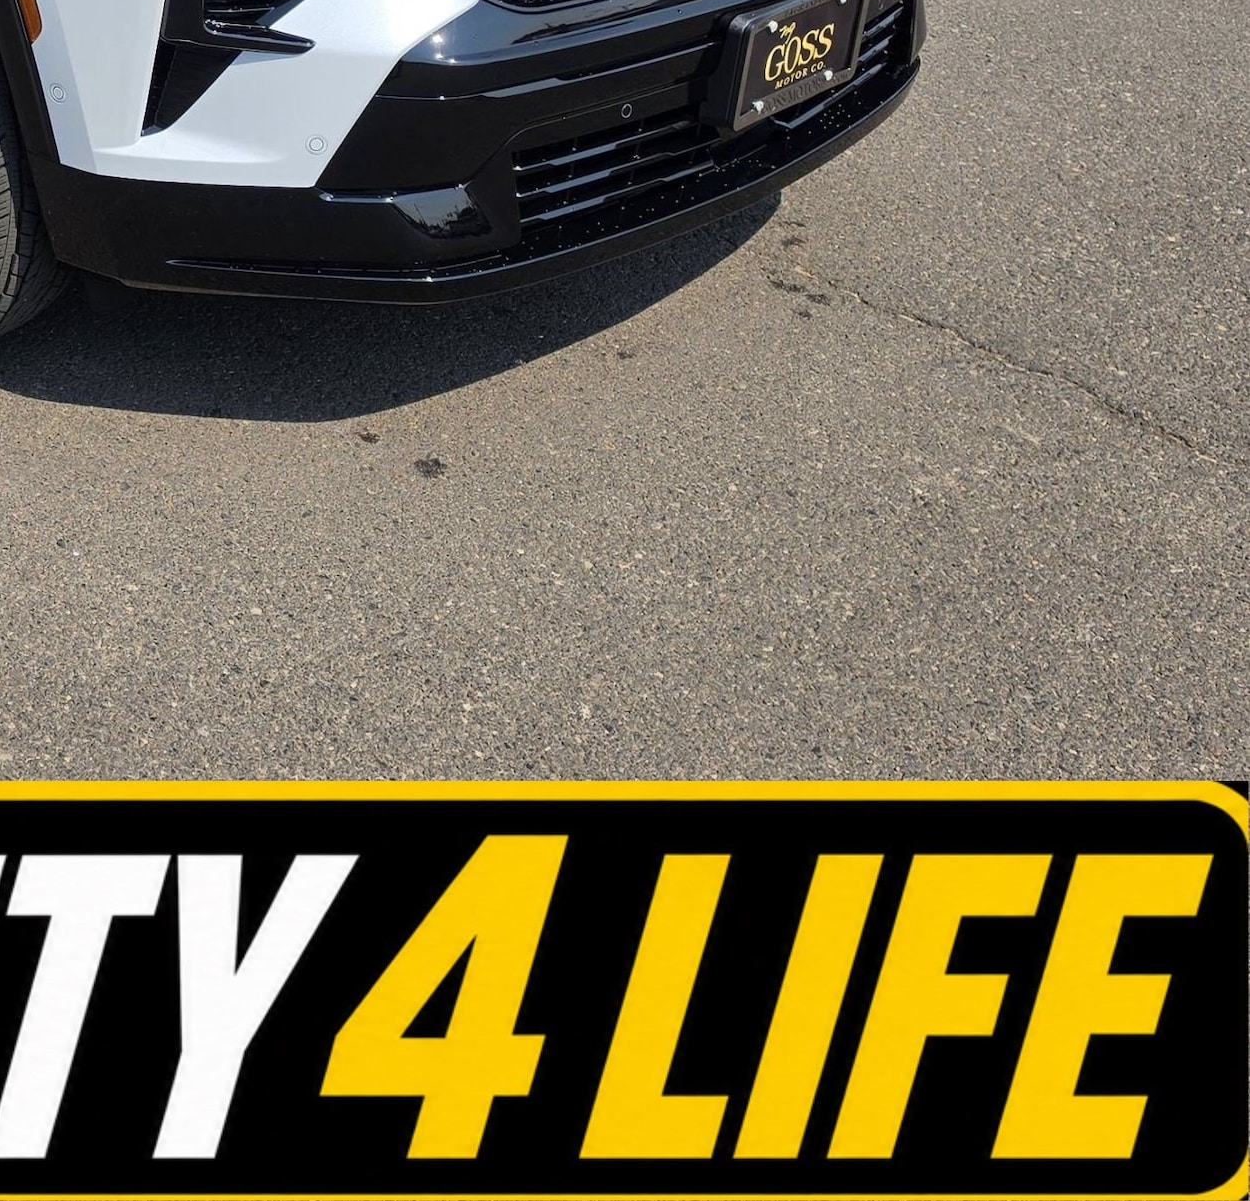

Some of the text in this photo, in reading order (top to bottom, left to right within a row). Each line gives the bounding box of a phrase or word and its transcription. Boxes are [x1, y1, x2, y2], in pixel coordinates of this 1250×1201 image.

[764, 23, 835, 82] GOSS
[774, 60, 827, 90] MOTOR CO.
